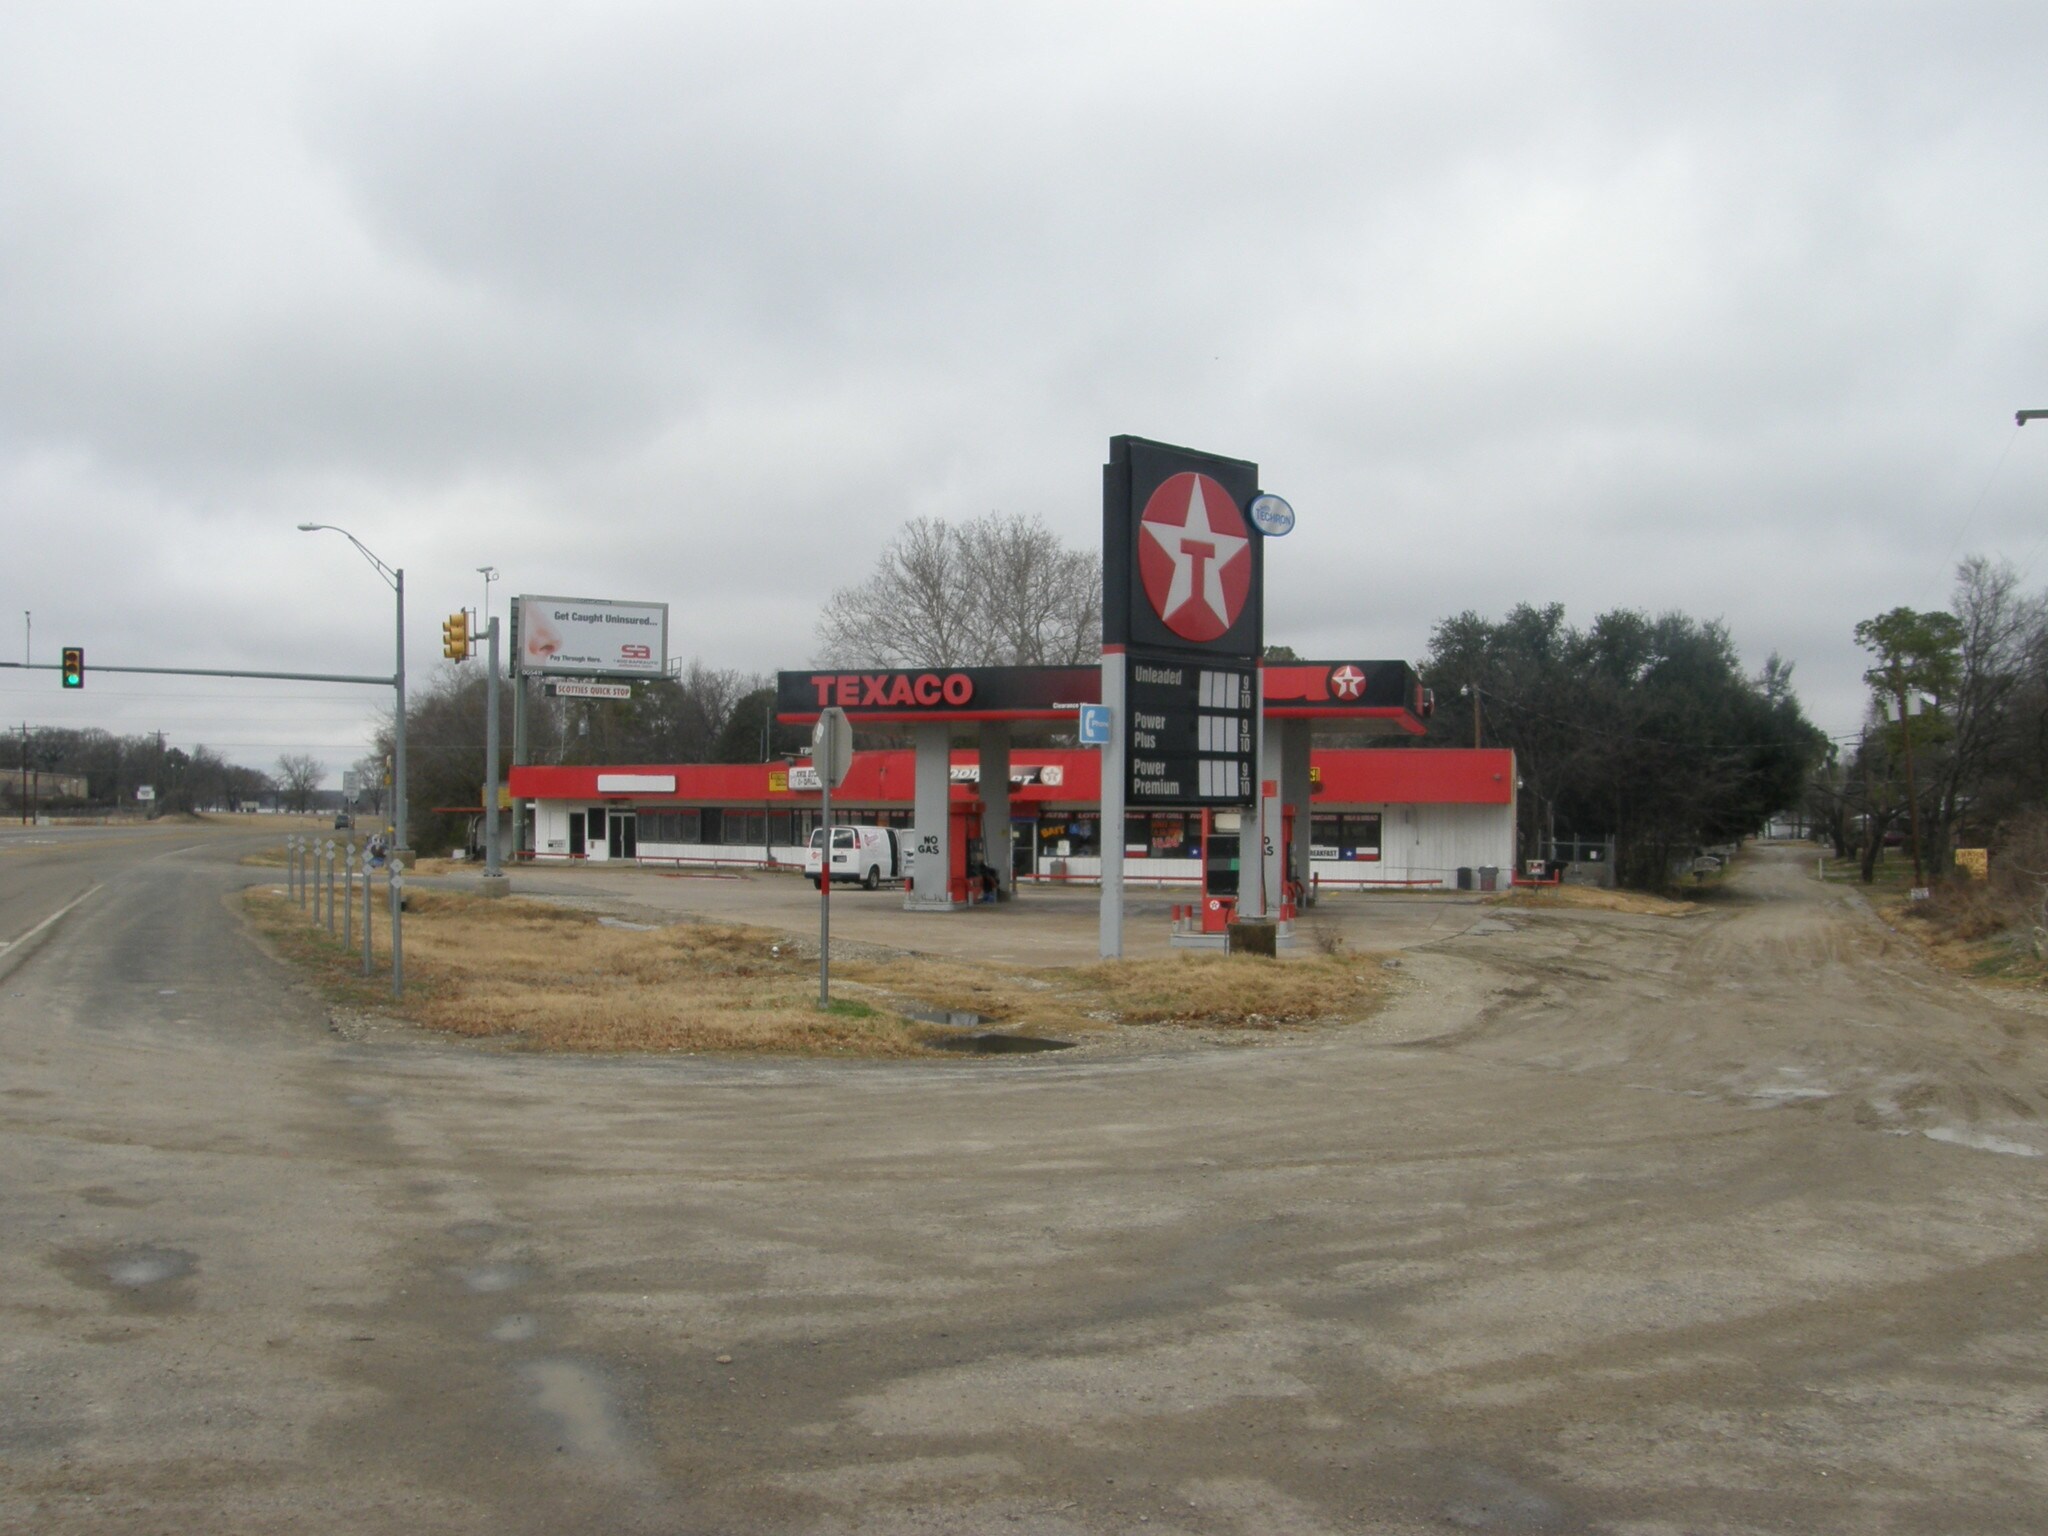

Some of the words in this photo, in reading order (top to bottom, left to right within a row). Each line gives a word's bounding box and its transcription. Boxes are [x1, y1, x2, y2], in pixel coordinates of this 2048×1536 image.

[1255, 508, 1292, 526] TECHRON
[554, 611, 569, 621] Get
[571, 612, 603, 625] Caught
[605, 614, 658, 626] Uninsured...
[562, 655, 586, 664] Through
[1135, 665, 1182, 685] Unleaded
[1243, 675, 1250, 690] 9
[590, 687, 611, 696] QUICK
[613, 687, 630, 696] STOP
[811, 673, 973, 706] TEXACO
[1241, 694, 1251, 709] 10
[1134, 712, 1166, 730] Power
[1242, 719, 1249, 734] 9
[1134, 731, 1156, 749] Plus
[1240, 737, 1250, 753] 10
[1133, 758, 1166, 776] Power
[1242, 762, 1248, 777] 9
[1133, 778, 1180, 795] Premium
[1240, 781, 1250, 796] 10
[923, 835, 938, 844] NO
[917, 844, 939, 855] GAS
[1310, 849, 1337, 857] REAKFAST
